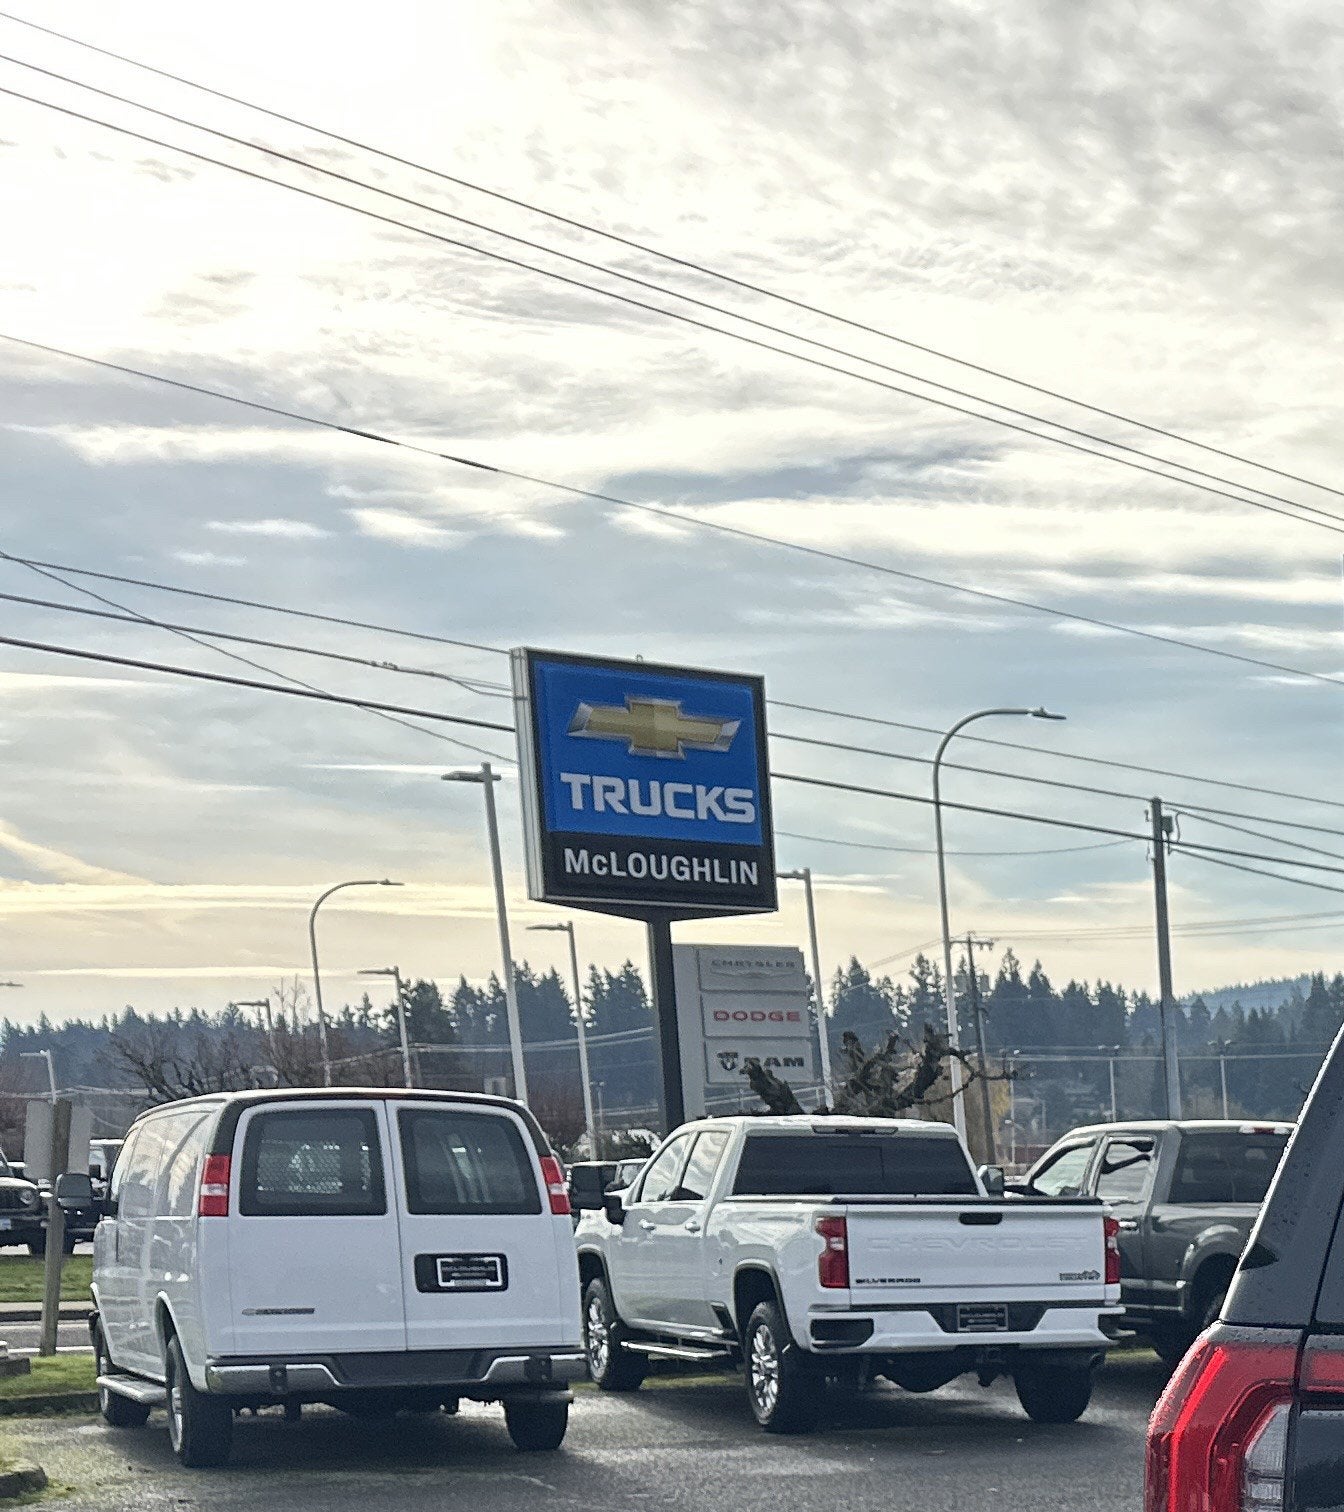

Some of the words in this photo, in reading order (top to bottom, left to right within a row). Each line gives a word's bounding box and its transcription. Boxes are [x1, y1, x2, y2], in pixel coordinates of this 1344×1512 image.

[560, 772, 755, 824] TRUCKS
[563, 847, 758, 886] McLOUGHLIN
[713, 1010, 800, 1022] DODGE
